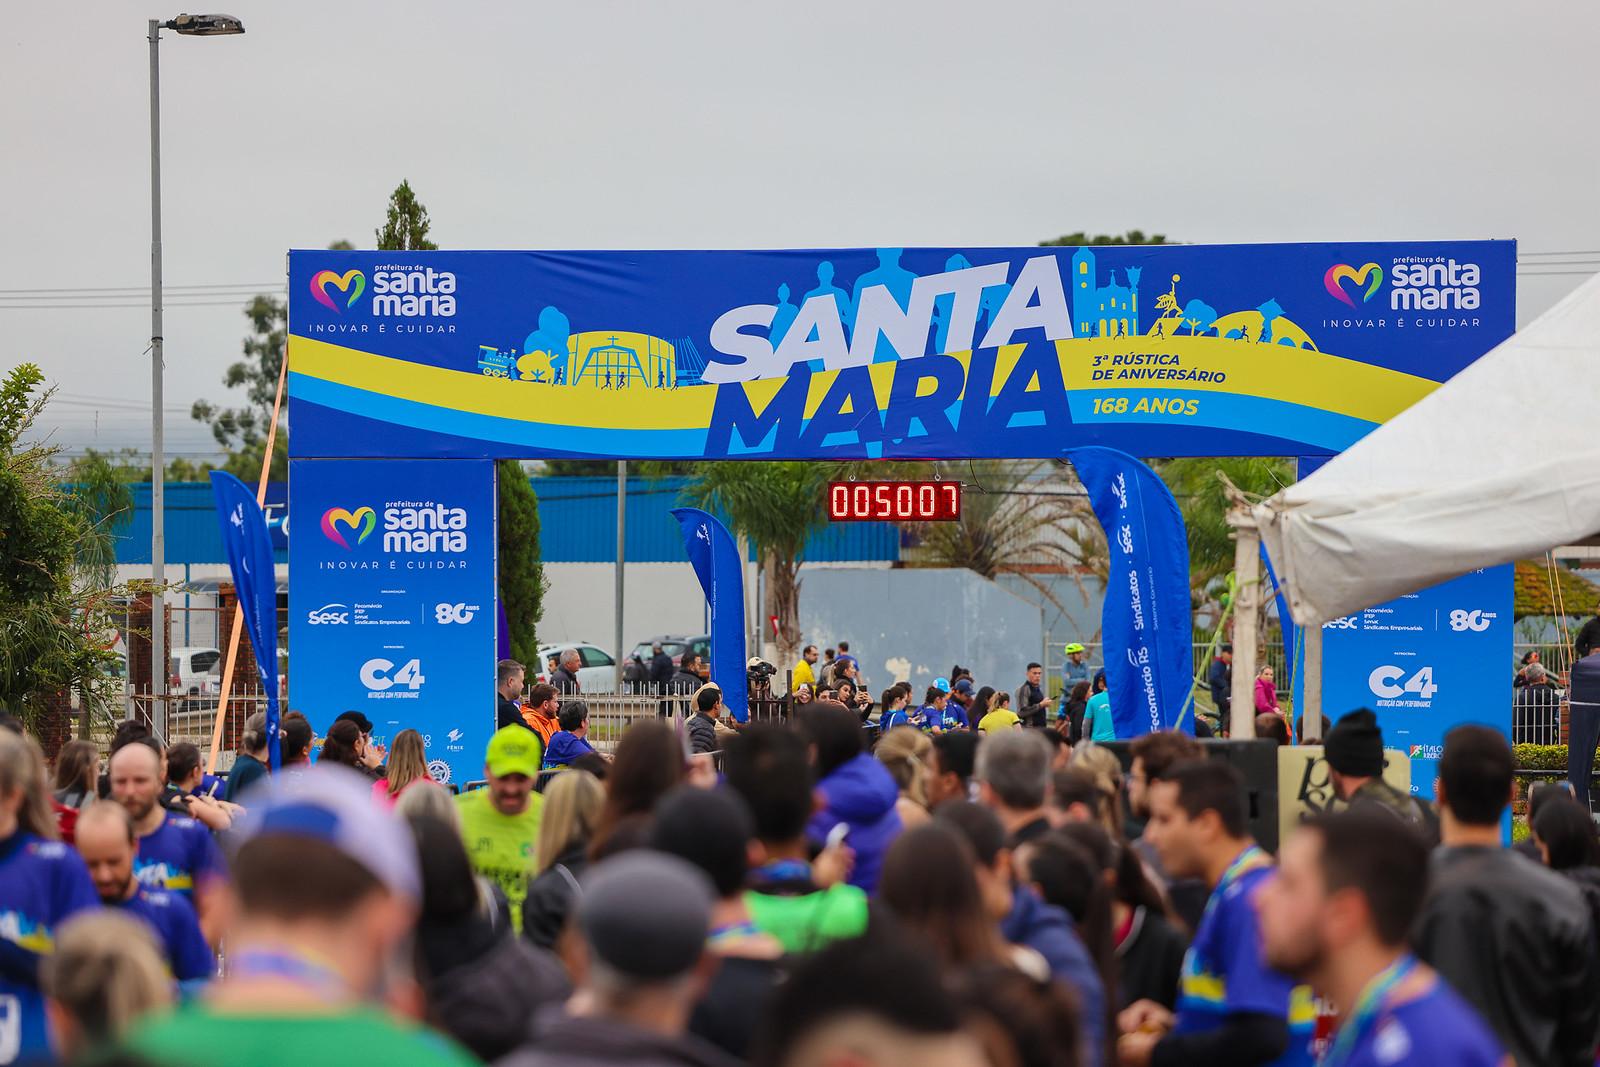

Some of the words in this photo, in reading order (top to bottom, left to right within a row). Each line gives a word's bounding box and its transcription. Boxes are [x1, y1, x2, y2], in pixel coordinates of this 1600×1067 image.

[374, 264, 412, 272] prefeitura
[1393, 256, 1433, 264] prefeitura
[373, 267, 456, 294] santa
[1391, 259, 1480, 287] santa
[373, 294, 456, 317] maria
[1391, 287, 1480, 311] maria
[309, 324, 369, 333] INOVAR
[379, 322, 386, 333] É
[396, 324, 456, 333] CUIDAR
[700, 254, 1074, 384] SANTA
[1323, 319, 1386, 328] INOVAR
[1397, 318, 1404, 328] É
[1416, 318, 1480, 328] CUIDAR
[1112, 352, 1180, 366] RÚSTICA
[1092, 369, 1114, 381] DE
[1117, 367, 1226, 383] ANIVERSÁRIO
[703, 341, 1075, 458] MARIA
[1093, 397, 1129, 414] 168
[1132, 397, 1200, 416] ANOS
[1115, 472, 1127, 509] Senac
[384, 504, 467, 530] santa
[383, 531, 467, 553] maria
[1119, 524, 1133, 554] Sesc
[319, 560, 379, 569] INOVAR
[389, 559, 396, 569] É
[406, 560, 468, 569] CUIDAR
[1129, 569, 1144, 630] Sindicatos
[307, 605, 349, 625] Sesc
[435, 602, 474, 625] 80
[1449, 609, 1490, 632] 80
[1138, 646, 1149, 664] RS
[359, 658, 425, 691] C4
[1369, 665, 1437, 699] C4
[1142, 665, 1160, 733] Fecomércio
